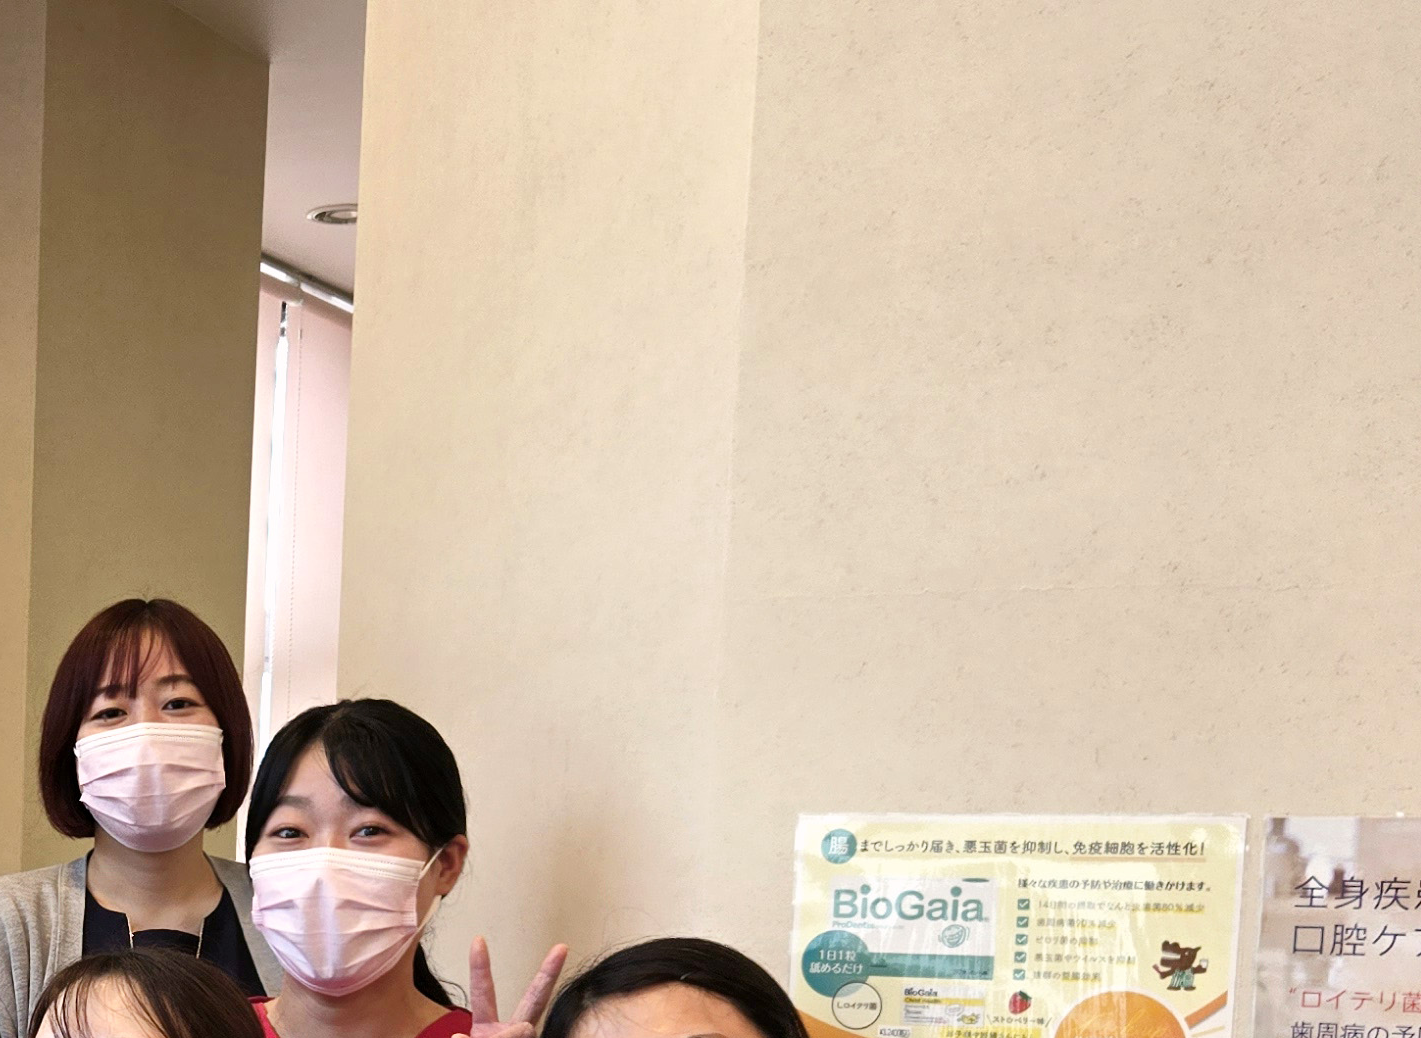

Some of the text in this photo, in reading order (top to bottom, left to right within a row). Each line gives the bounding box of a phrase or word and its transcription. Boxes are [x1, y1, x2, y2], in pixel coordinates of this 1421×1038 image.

[832, 883, 984, 922] BioGaia
[1293, 875, 1421, 911] 全身疾
[1291, 923, 1421, 957] 口腔ケ
